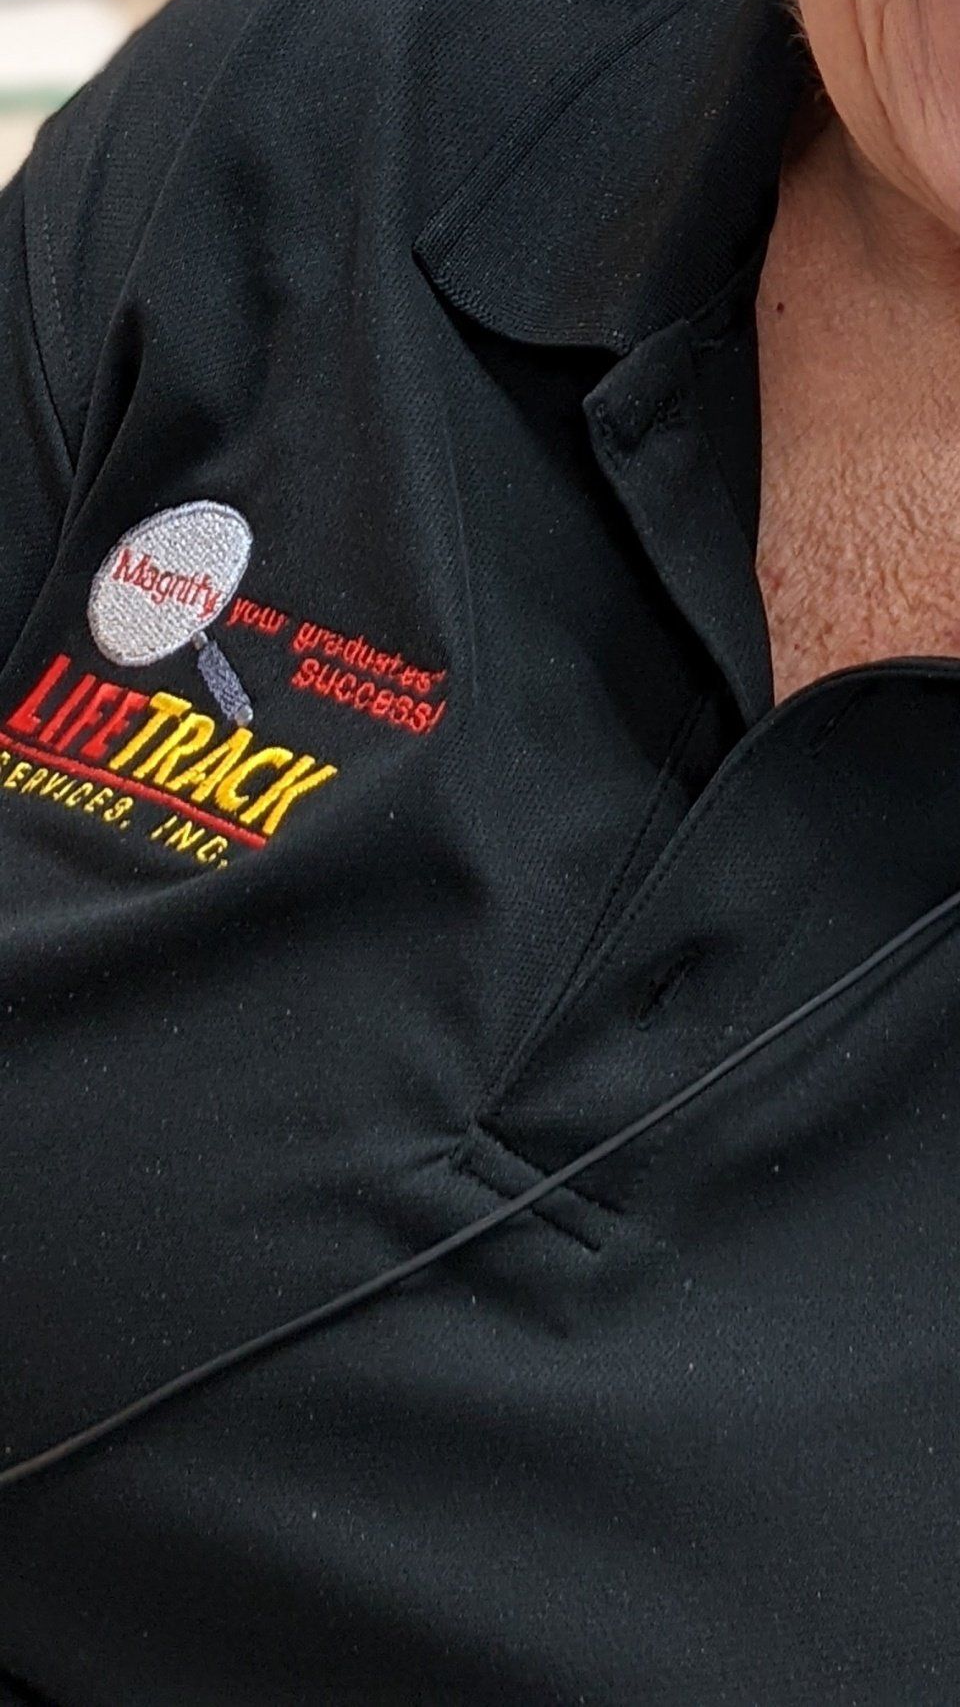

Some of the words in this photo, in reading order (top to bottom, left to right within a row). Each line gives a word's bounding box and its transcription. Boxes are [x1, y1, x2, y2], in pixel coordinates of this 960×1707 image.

[112, 548, 222, 619] Magnify
[6, 653, 338, 836] LIFETRACK
[150, 814, 229, 869] INC.
